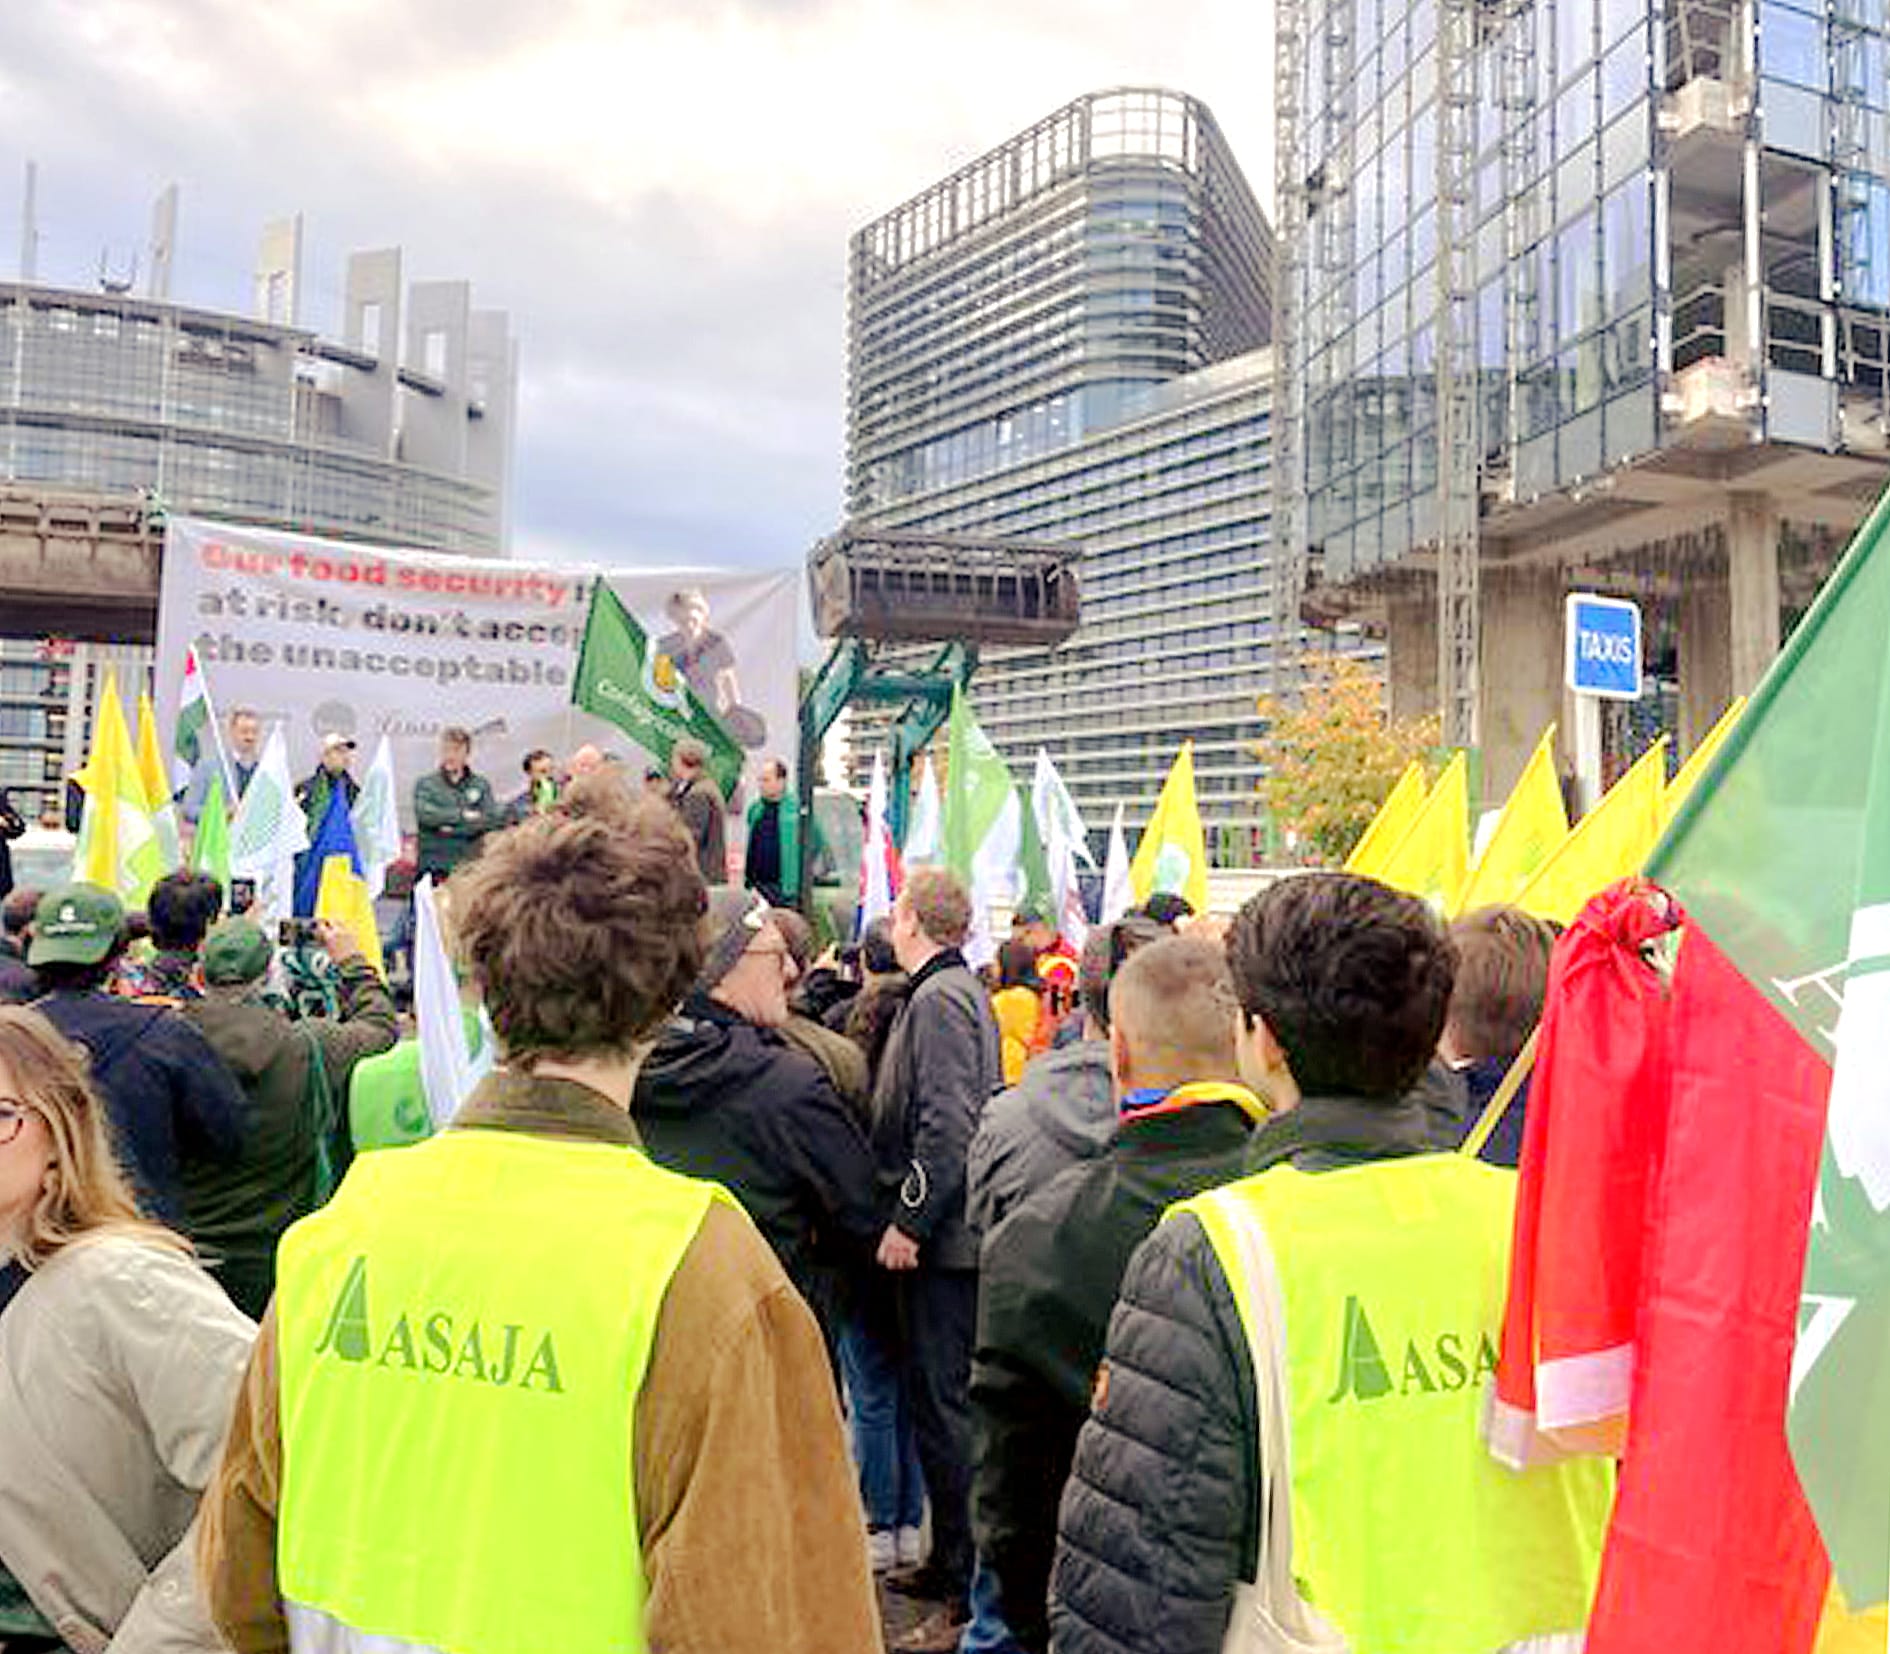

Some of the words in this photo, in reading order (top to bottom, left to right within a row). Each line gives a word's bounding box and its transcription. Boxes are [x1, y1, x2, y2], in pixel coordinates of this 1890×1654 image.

[197, 587, 247, 617] at
[202, 544, 283, 573] Our
[289, 553, 387, 584] food
[398, 568, 569, 607] security
[194, 632, 274, 666] the
[283, 643, 568, 687] unacceptable
[1580, 630, 1634, 664] TAXIS
[376, 1311, 565, 1394] ASAJA
[1400, 1331, 1500, 1396] ASA
